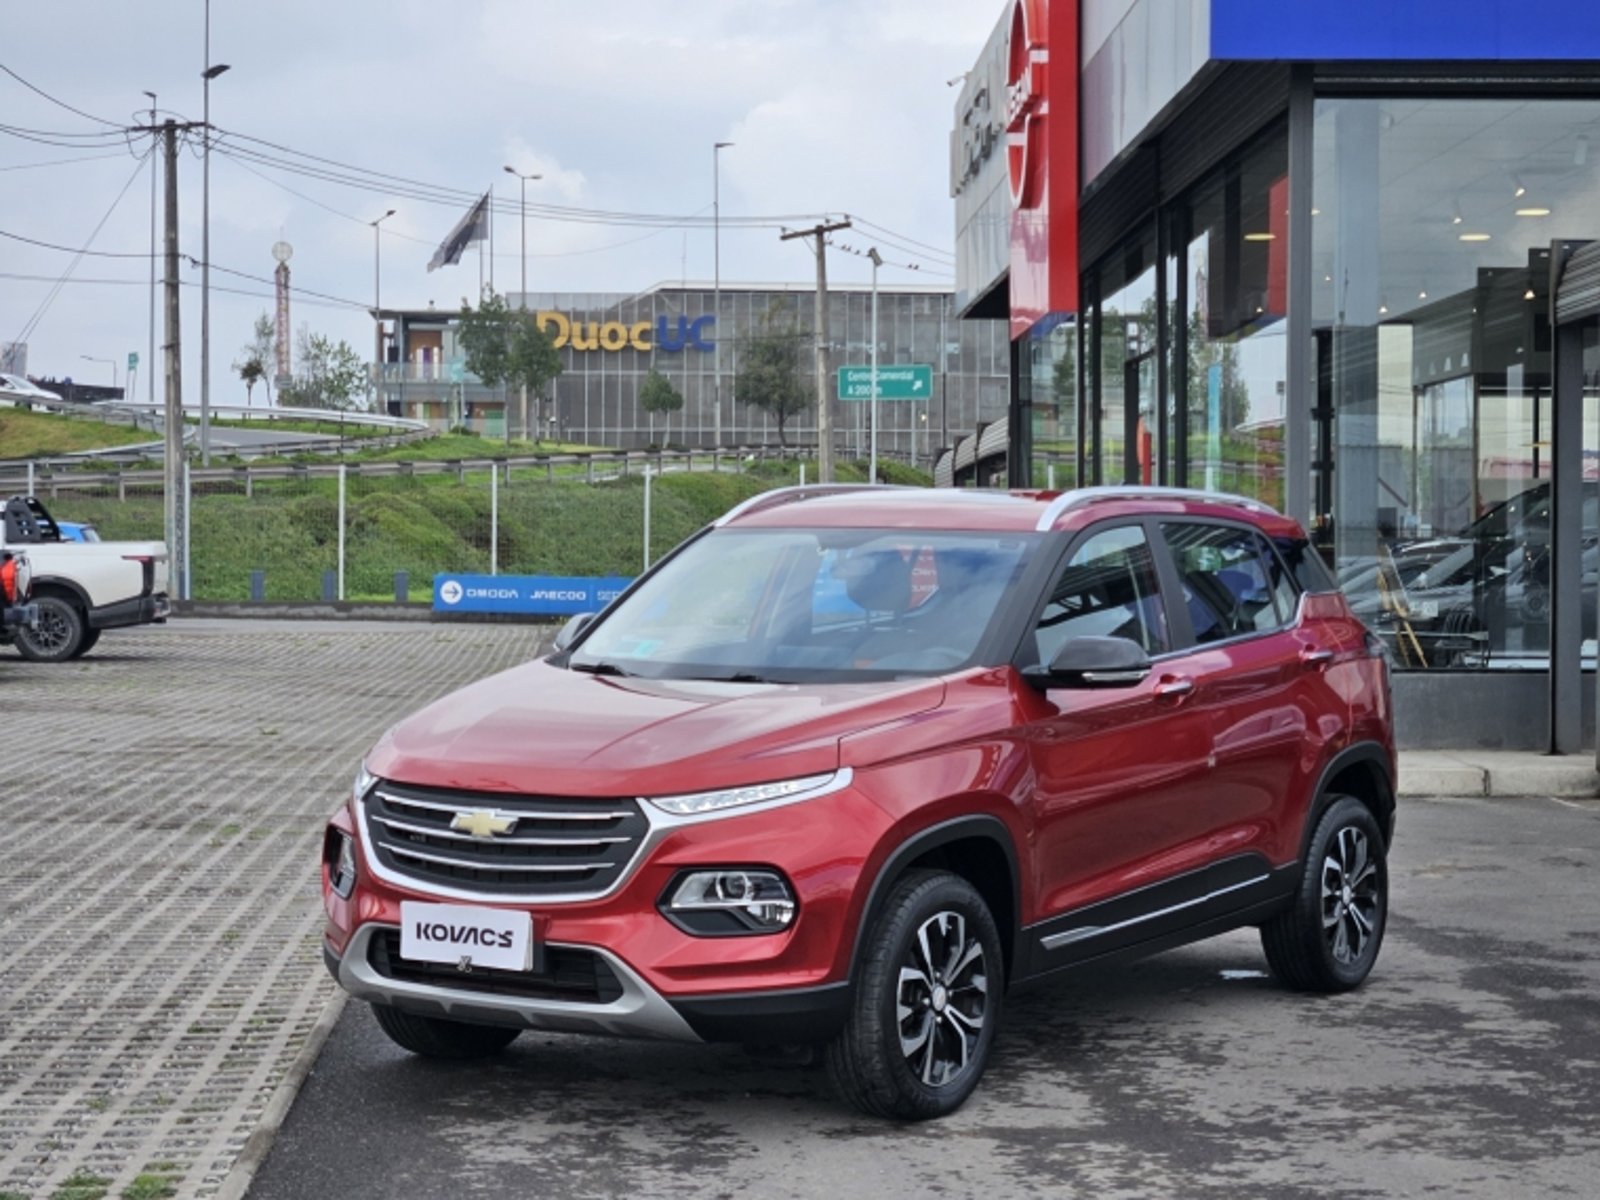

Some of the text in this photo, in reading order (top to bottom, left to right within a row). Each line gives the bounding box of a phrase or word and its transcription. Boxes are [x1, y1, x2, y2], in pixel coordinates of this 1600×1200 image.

[466, 588, 519, 599] OMODA
[529, 591, 587, 601] JAECOO
[416, 921, 513, 948] KOVACS
